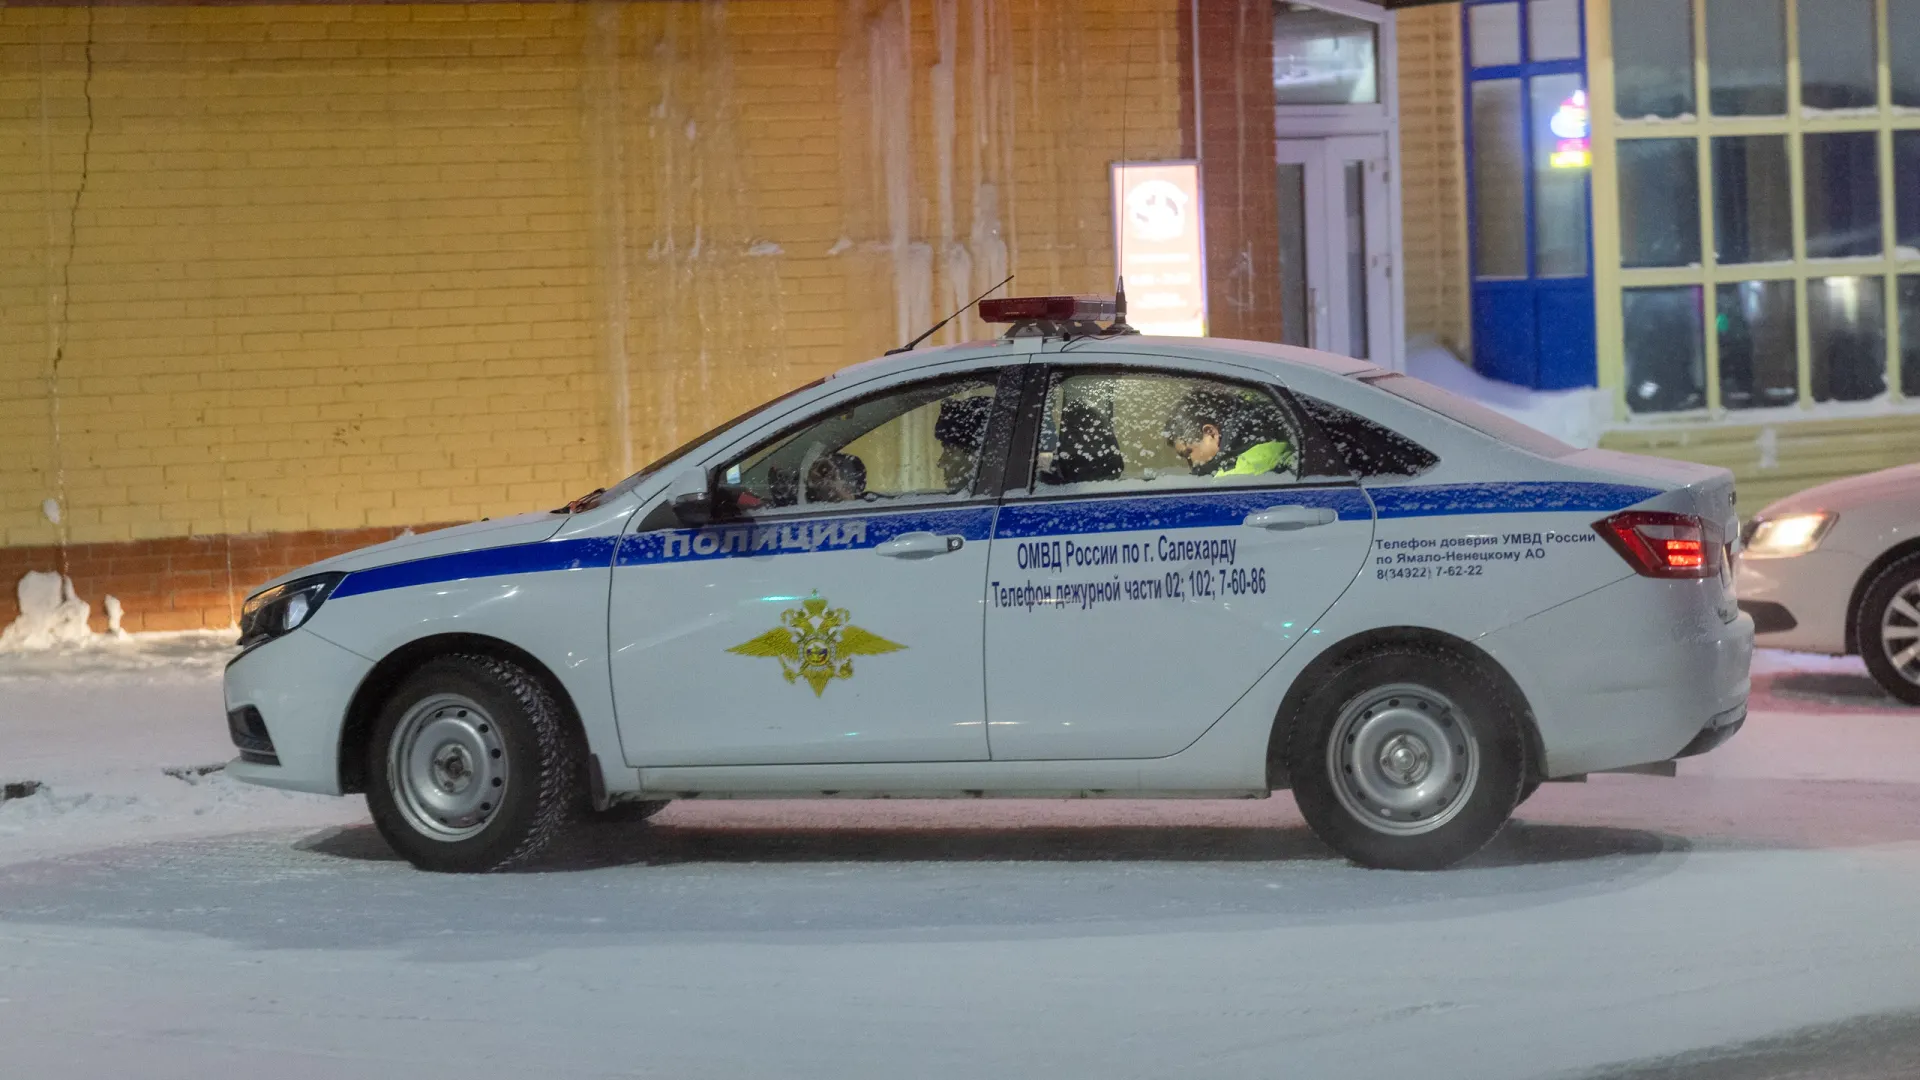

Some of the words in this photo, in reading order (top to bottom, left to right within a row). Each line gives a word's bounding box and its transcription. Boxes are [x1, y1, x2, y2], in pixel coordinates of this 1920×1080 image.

[663, 521, 867, 557] ПОЛИЦИЯ
[1376, 537, 1437, 550] Телефон
[1440, 535, 1498, 549] доверия
[1502, 533, 1542, 546] УМВД
[1546, 532, 1596, 544] России
[1017, 541, 1062, 572] ОМВД
[1066, 539, 1118, 567] России
[1122, 546, 1140, 564] по
[1144, 544, 1154, 563] г.
[1158, 534, 1237, 565] Салехарду
[1376, 555, 1393, 564] по
[1396, 550, 1520, 564] Ямало-Ненецкому
[1525, 548, 1546, 559] АО
[1376, 566, 1432, 581] 8(34922)
[1436, 565, 1483, 577] 7-62-22
[991, 580, 1051, 612] Телефон
[1055, 575, 1121, 609] дежурной
[1125, 578, 1162, 601] части
[1165, 571, 1186, 603] 02;
[1189, 569, 1216, 601] 102;
[1220, 567, 1267, 596] 7-60-86
